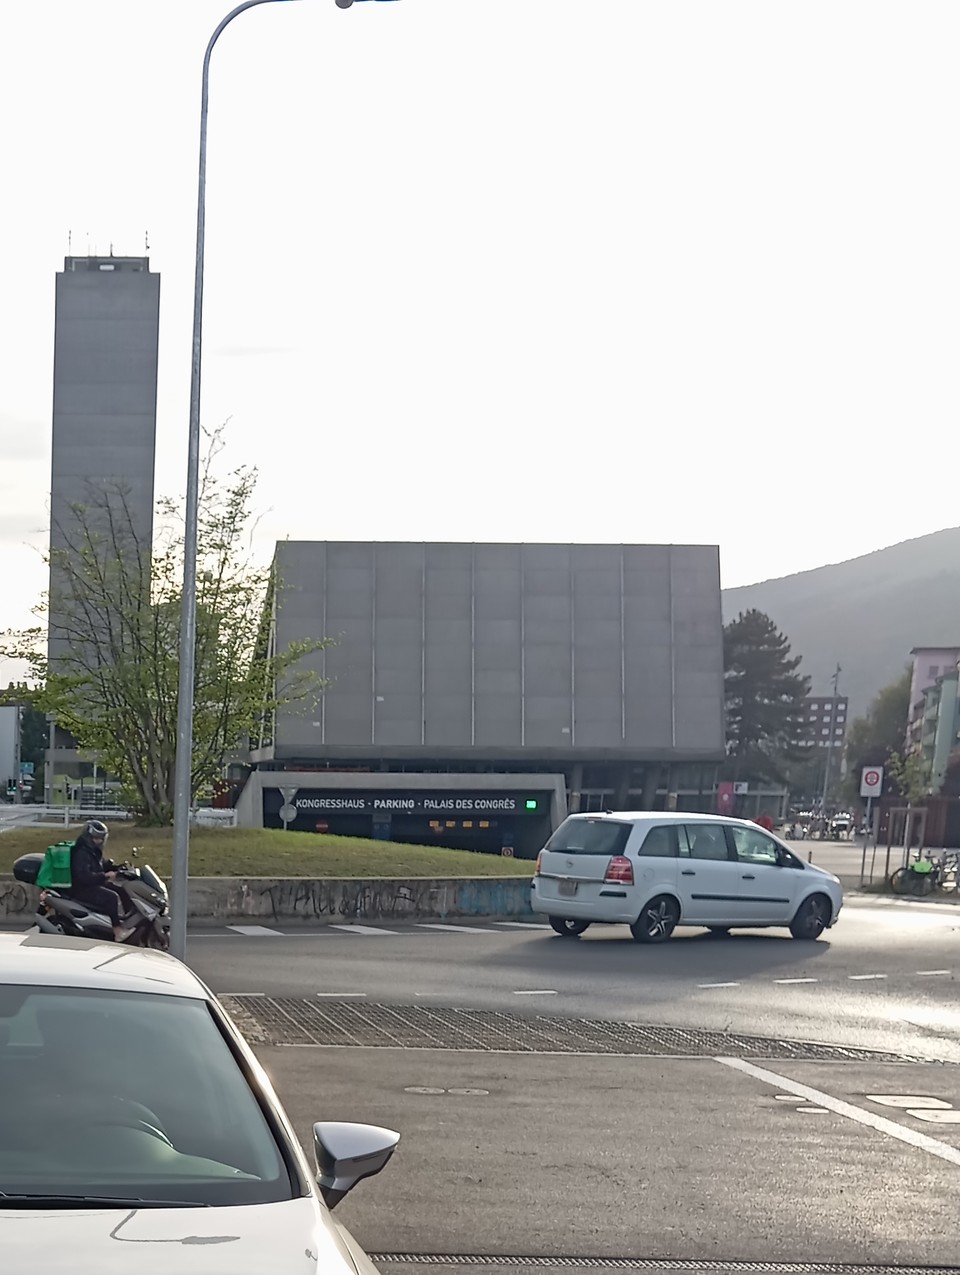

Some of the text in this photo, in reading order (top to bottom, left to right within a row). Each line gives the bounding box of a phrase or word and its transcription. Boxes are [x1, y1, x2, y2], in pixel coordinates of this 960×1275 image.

[295, 798, 365, 809] KONGRESSHAUS
[374, 799, 415, 809] PARKING
[423, 799, 454, 809] PALAIS
[455, 799, 473, 809] DES
